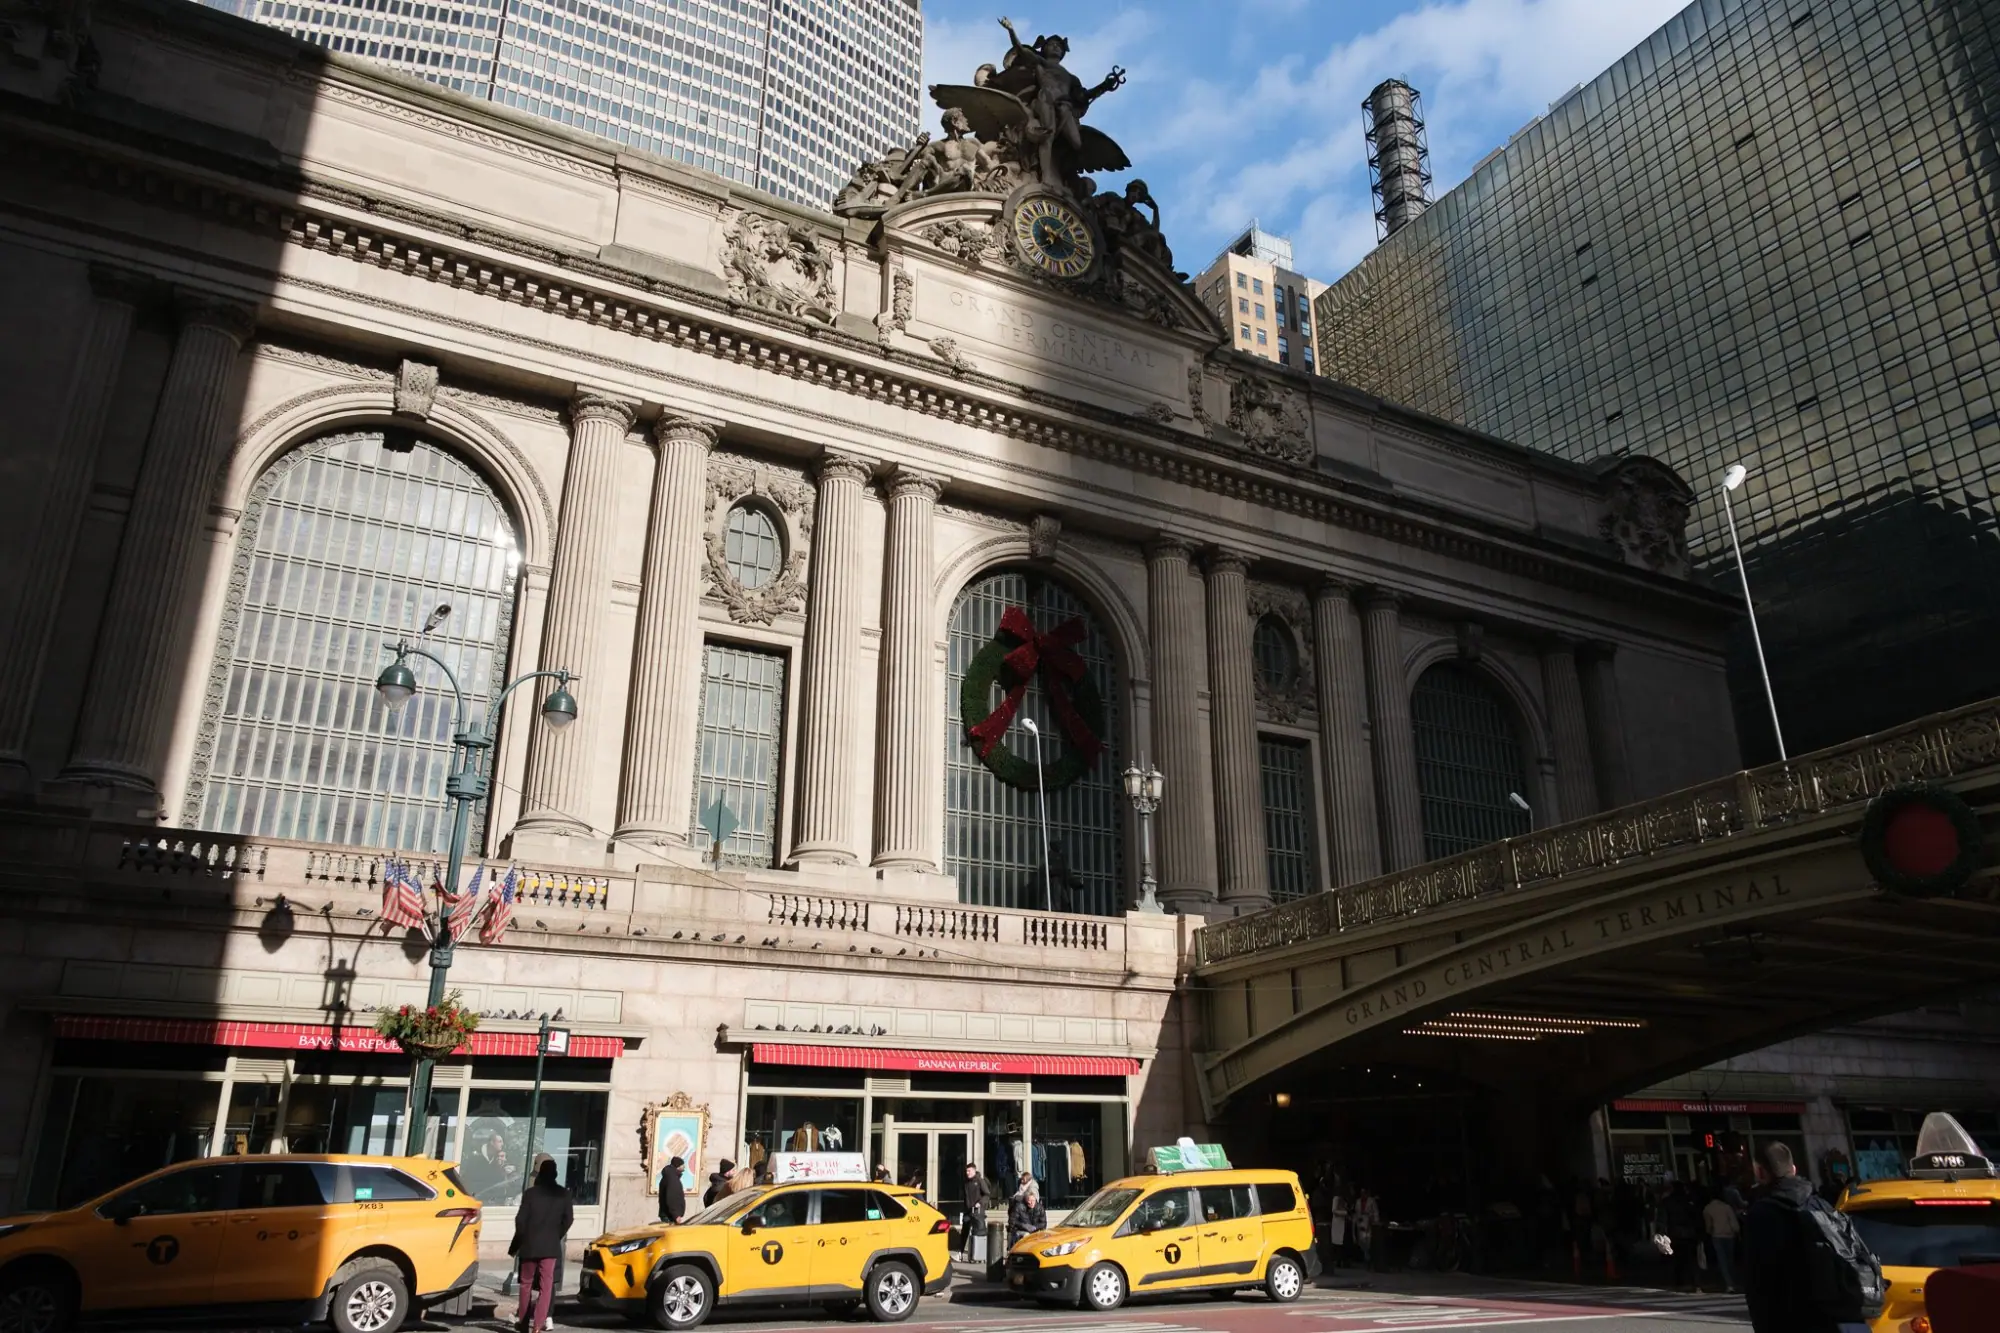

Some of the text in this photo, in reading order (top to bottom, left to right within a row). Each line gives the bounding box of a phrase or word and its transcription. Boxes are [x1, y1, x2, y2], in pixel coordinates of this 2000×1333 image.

[949, 291, 1155, 368] GRAND CENTRAL
[997, 322, 1113, 372] TERMINAL
[1345, 875, 1790, 1025] GRAND CENTRAL TERMINAL
[298, 1035, 403, 1051] BANANA REPUB
[918, 1059, 1002, 1071] BANANA REPUBLIC
[1624, 1153, 1660, 1163] HOLIDAY
[1931, 1155, 1965, 1168] 9V86
